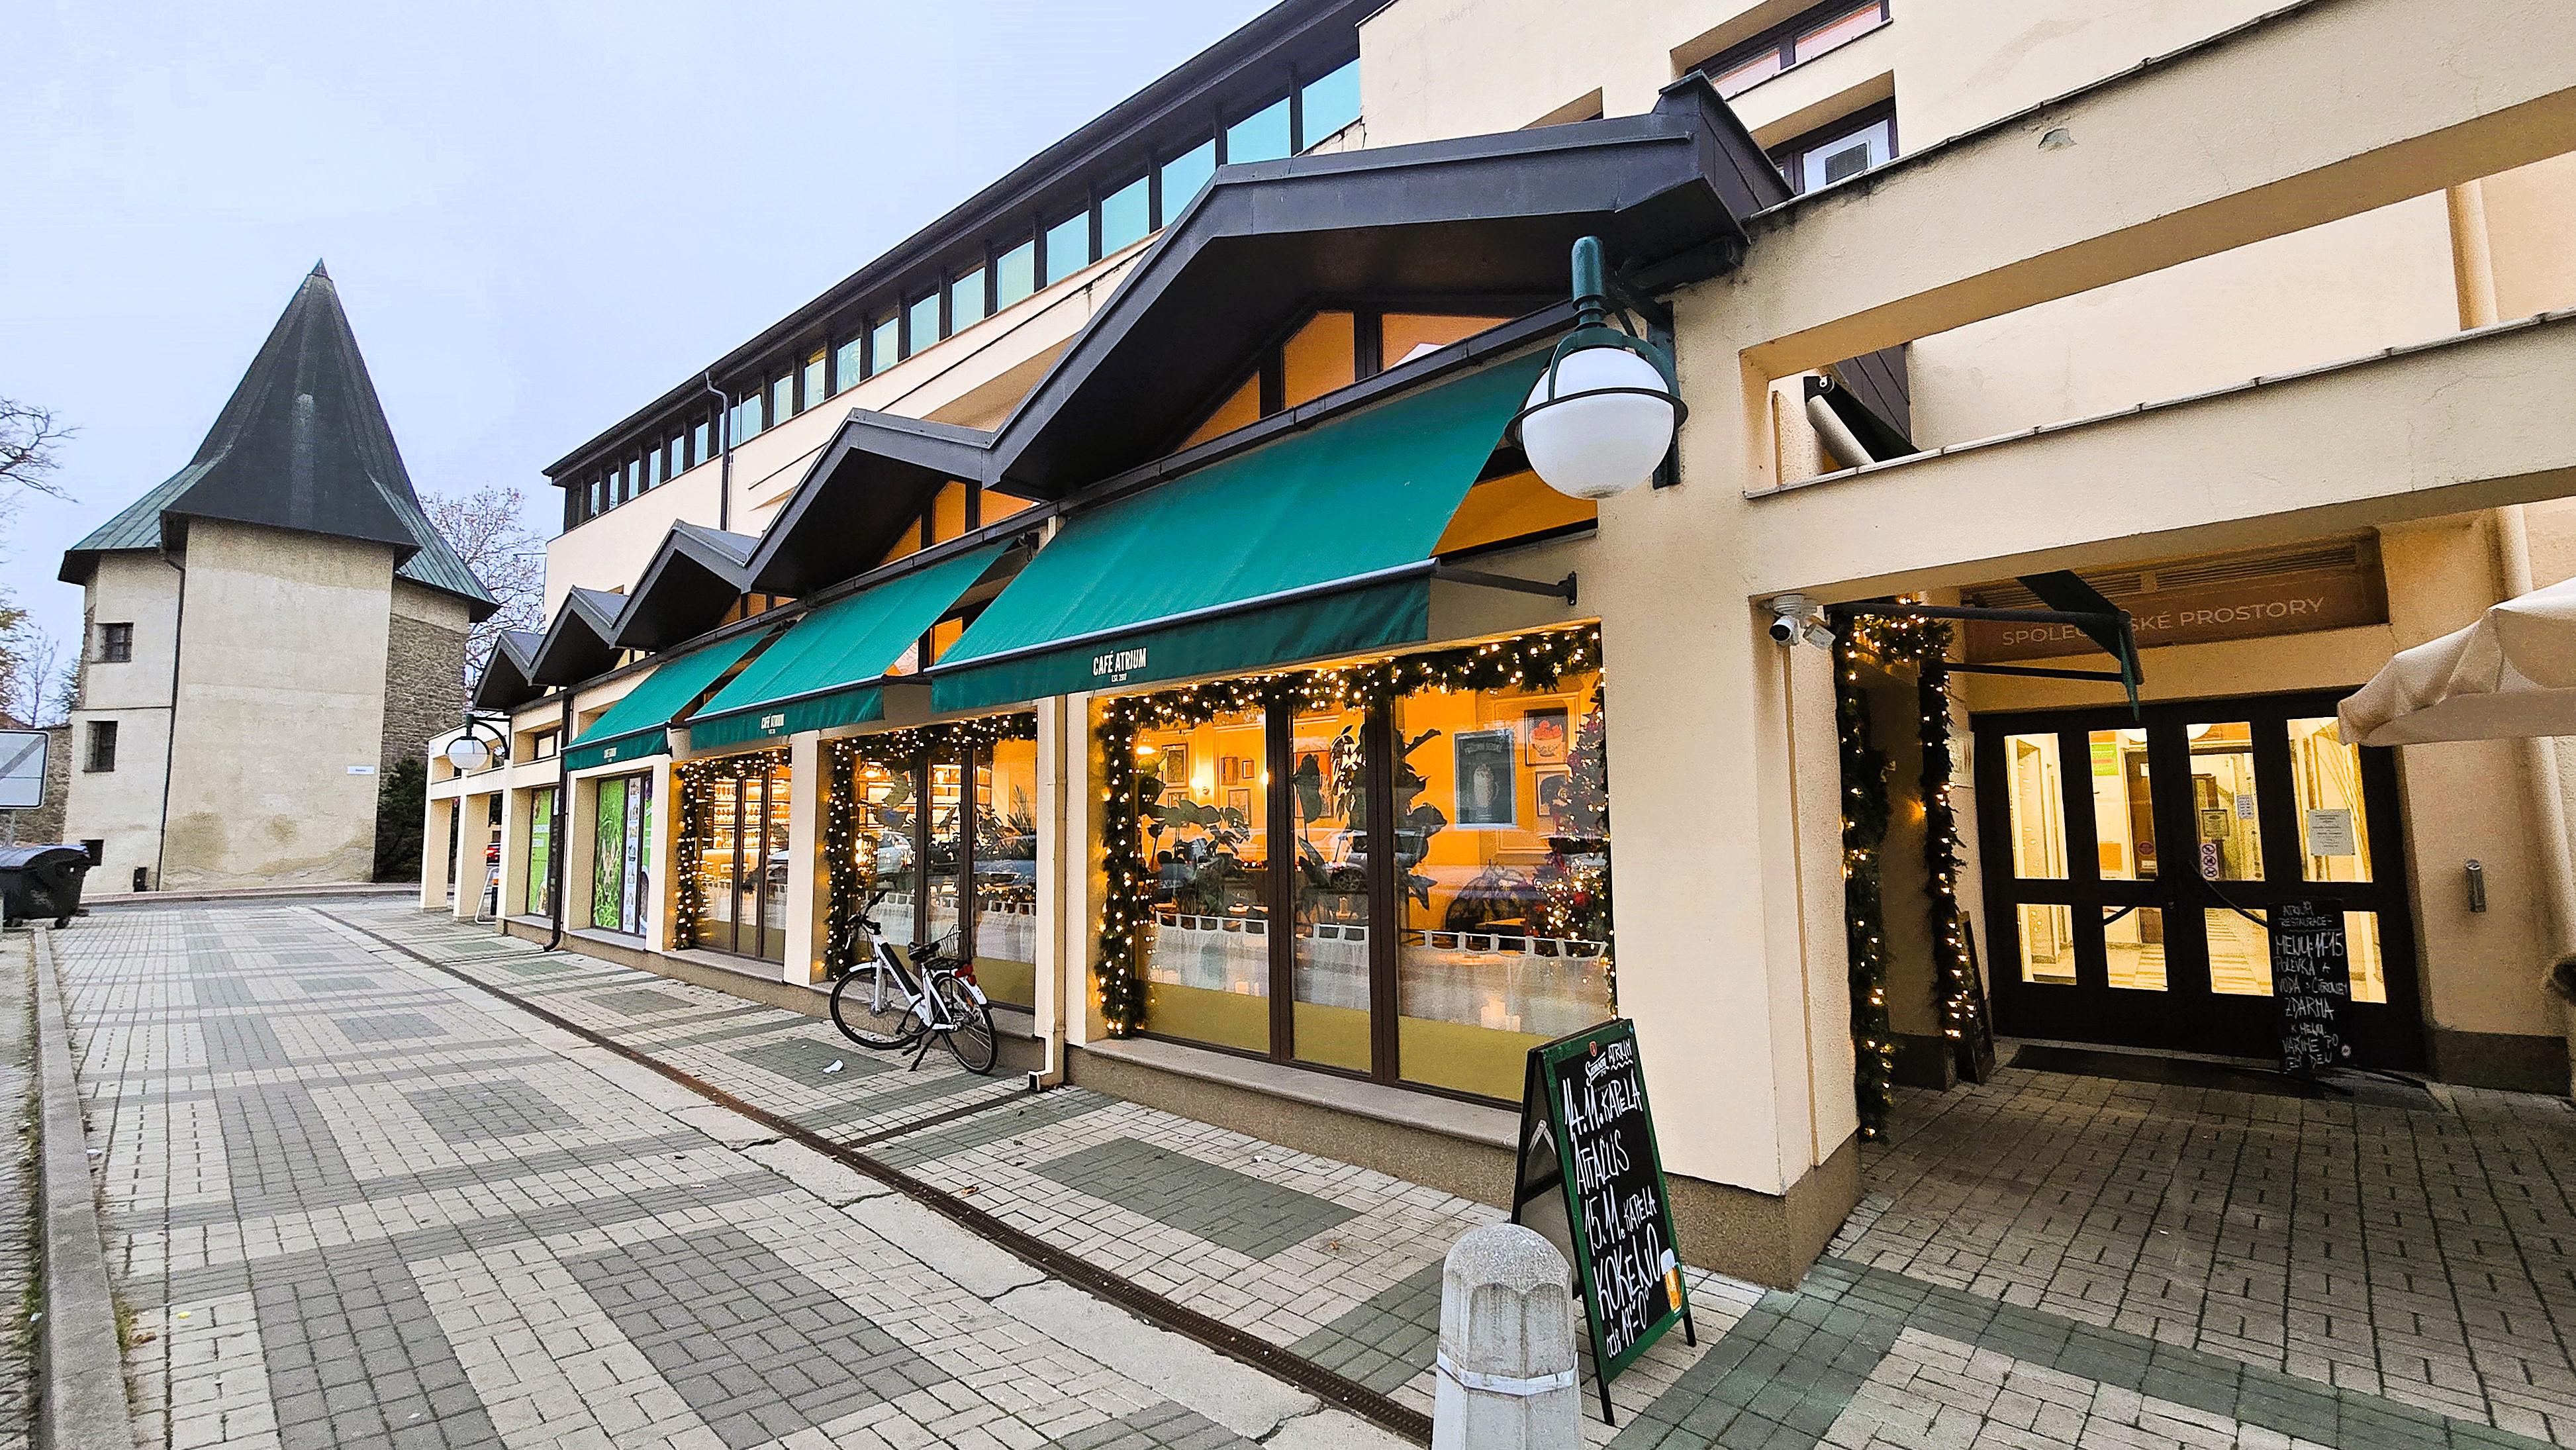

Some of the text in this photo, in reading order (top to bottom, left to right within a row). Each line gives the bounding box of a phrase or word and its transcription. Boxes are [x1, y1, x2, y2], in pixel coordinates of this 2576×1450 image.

[2002, 597, 2324, 646] SPOLESKÉ PROSTORY
[1093, 648, 1147, 676] CAFÉ ATRIUM
[1623, 1185, 1657, 1232] KAPELA
